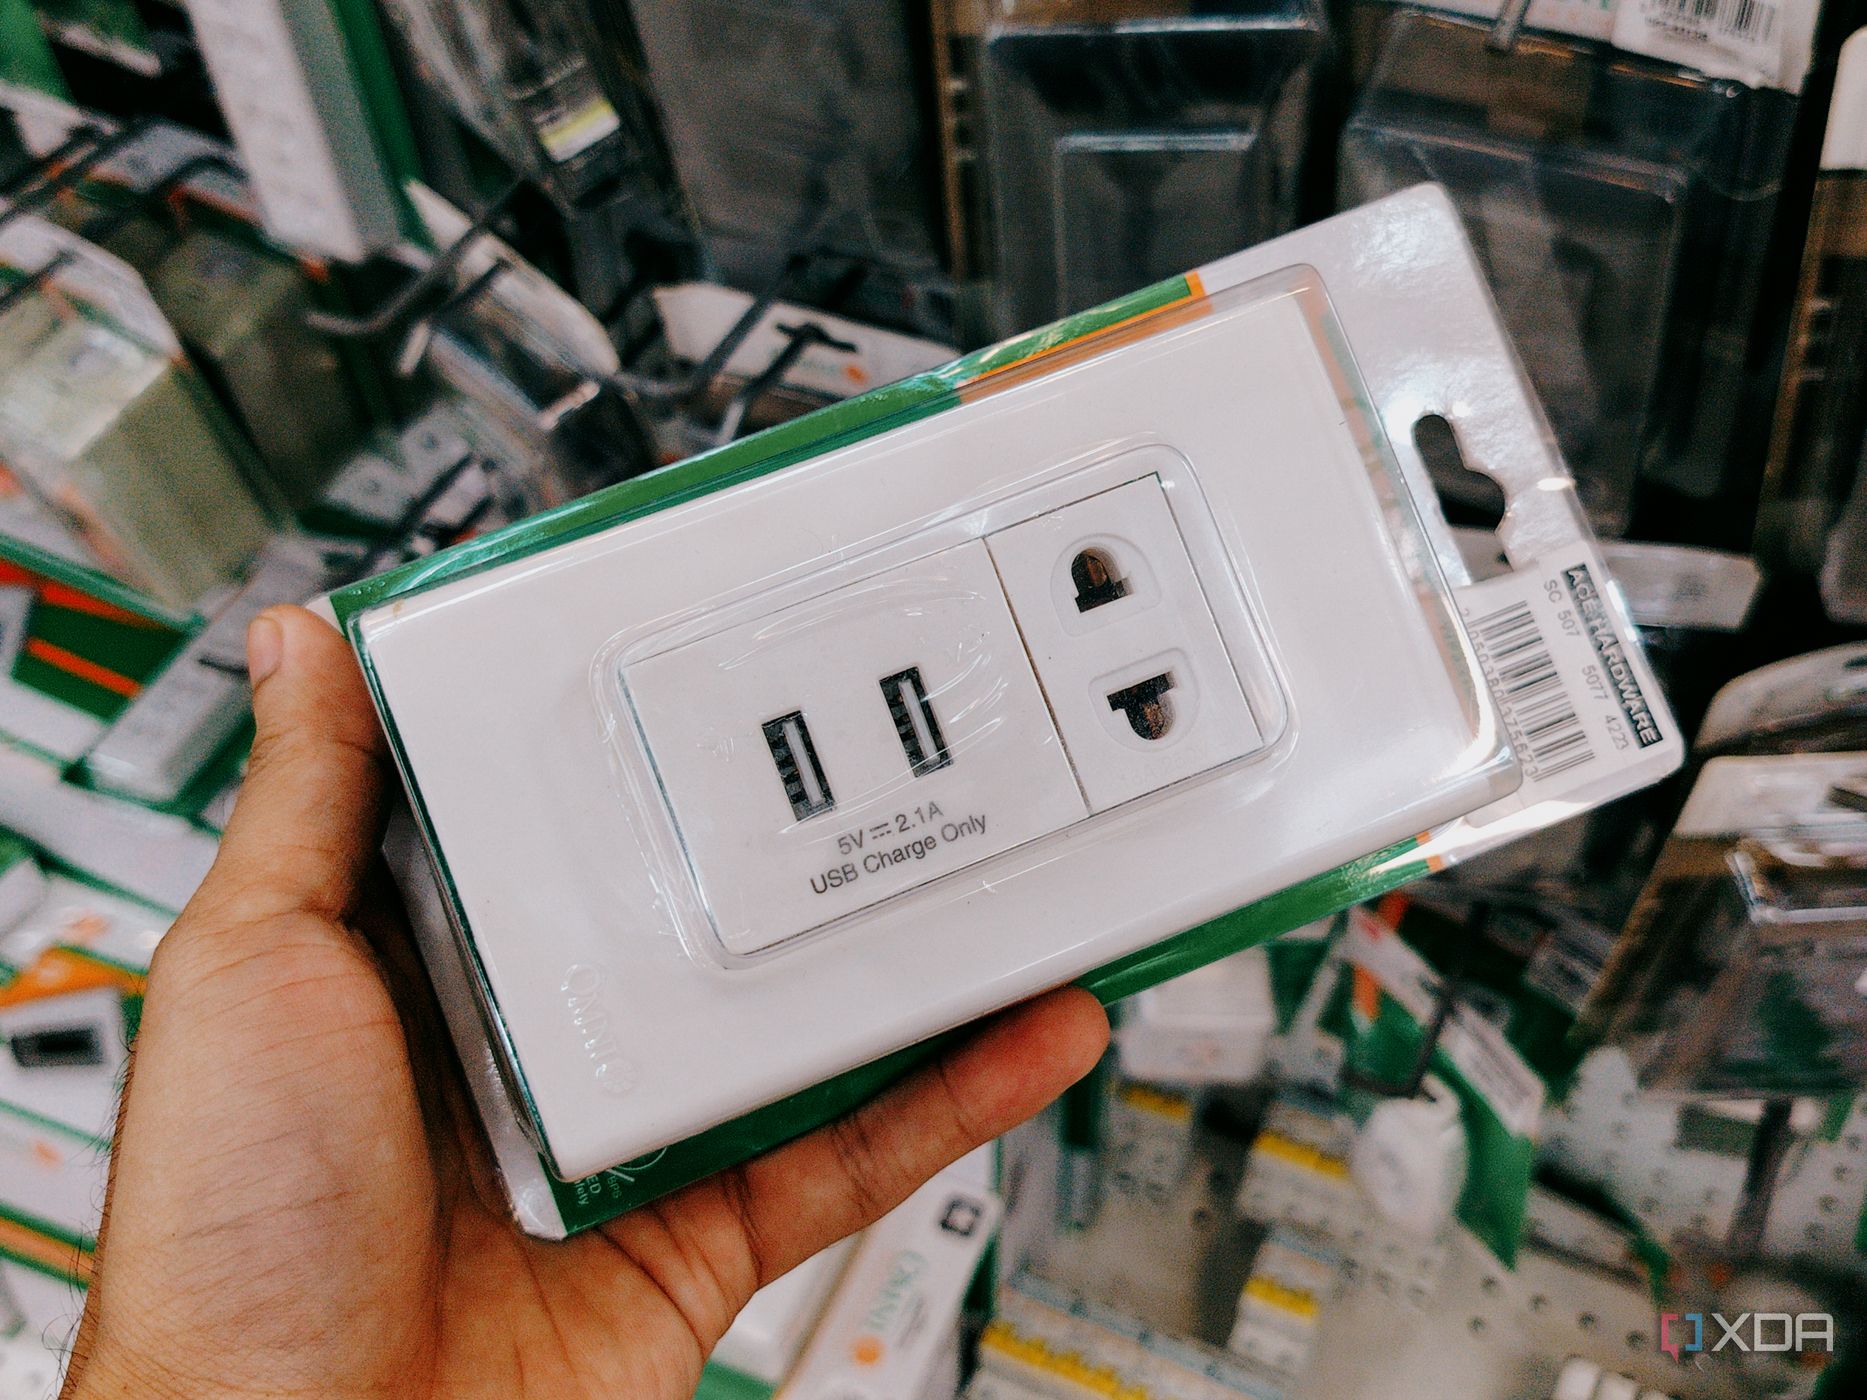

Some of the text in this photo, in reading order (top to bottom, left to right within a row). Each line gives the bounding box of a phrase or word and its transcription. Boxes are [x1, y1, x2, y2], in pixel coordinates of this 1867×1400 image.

[1544, 579, 1629, 751] SC 507 5077 4223
[1568, 568, 1656, 746] ACE HARDWARE
[810, 814, 987, 895] USB Charge Only
[838, 801, 944, 855] 5V 2.1A
